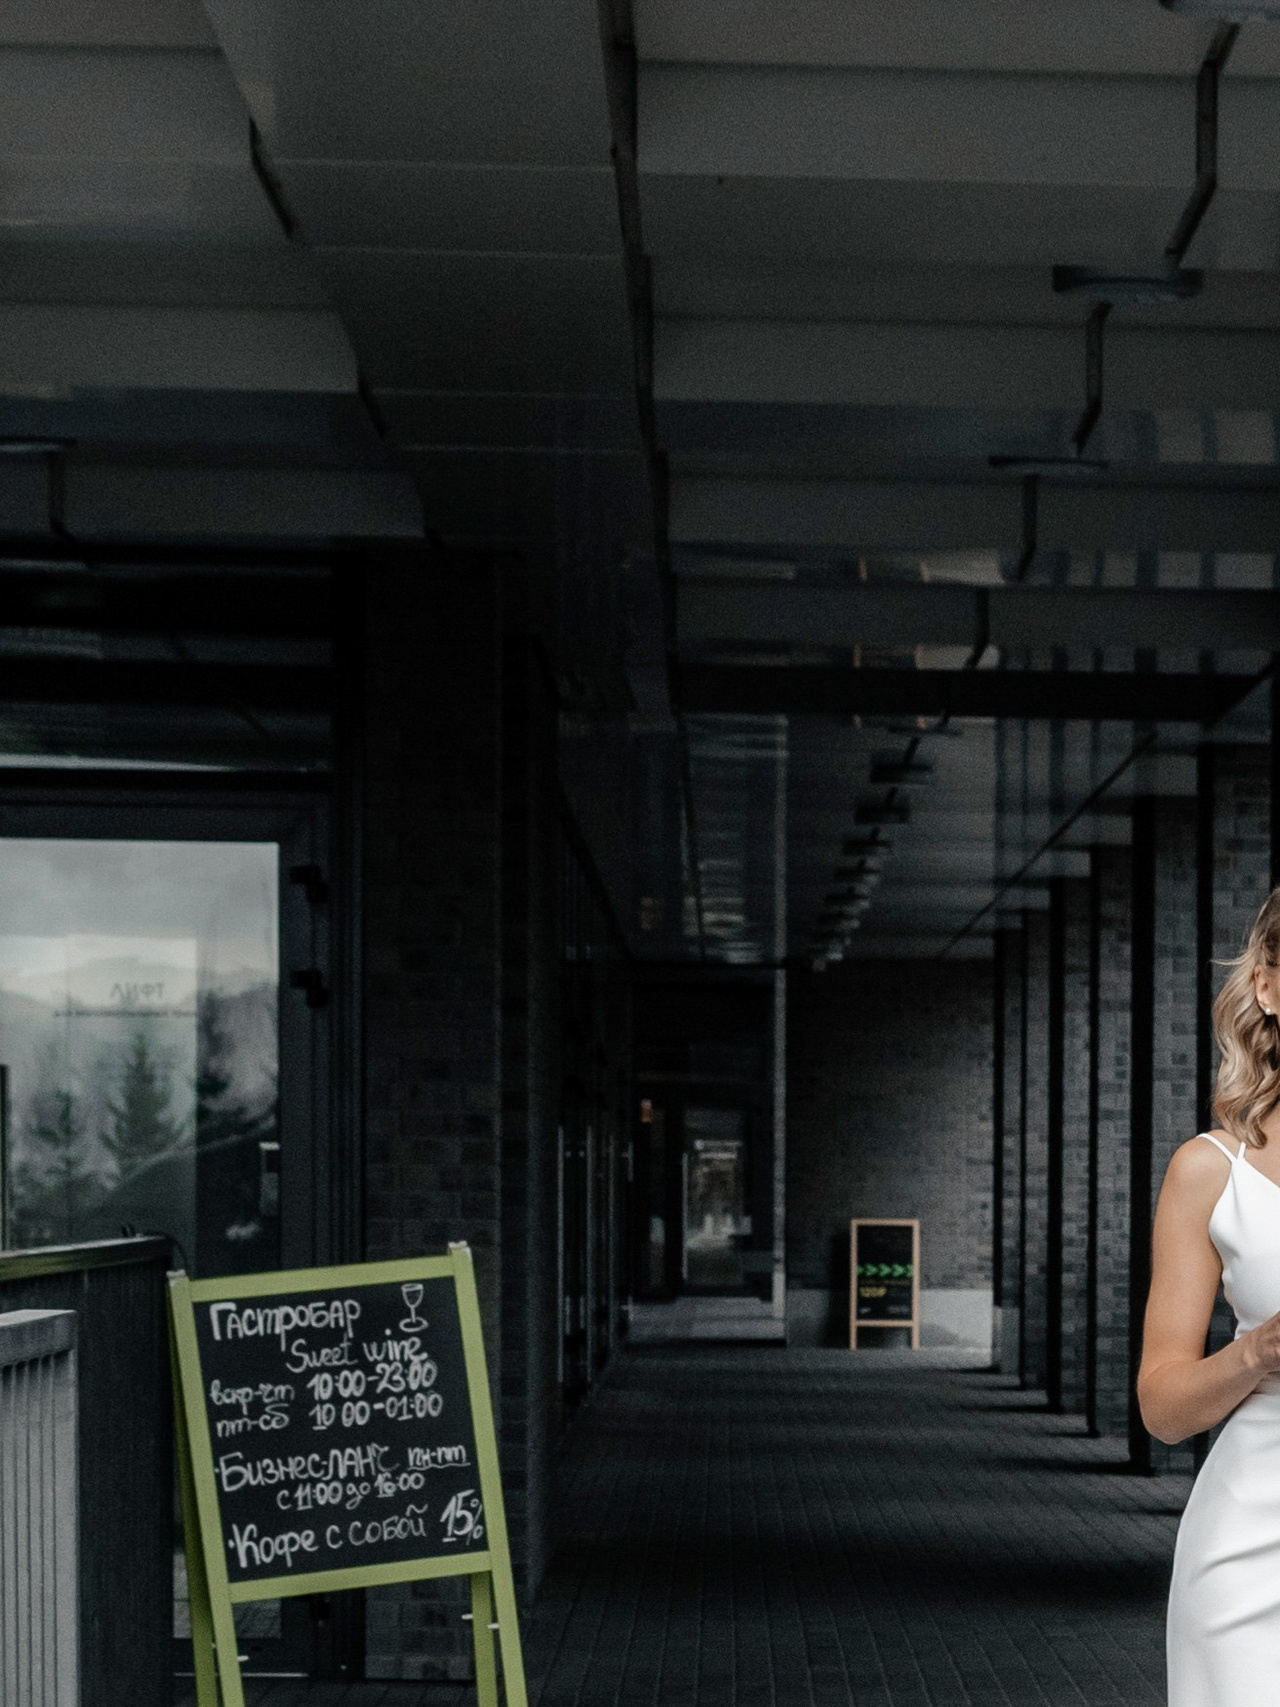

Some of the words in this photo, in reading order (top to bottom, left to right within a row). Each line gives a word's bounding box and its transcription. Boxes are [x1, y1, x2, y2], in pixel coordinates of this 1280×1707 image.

[286, 1331, 358, 1374] Sweet
[363, 1328, 428, 1362] wine
[294, 1480, 342, 1511] 11:00
[346, 1482, 371, 1510] до
[374, 1472, 425, 1498] 16:00
[232, 1523, 319, 1569] Кофе
[440, 1489, 484, 1546] 15%
